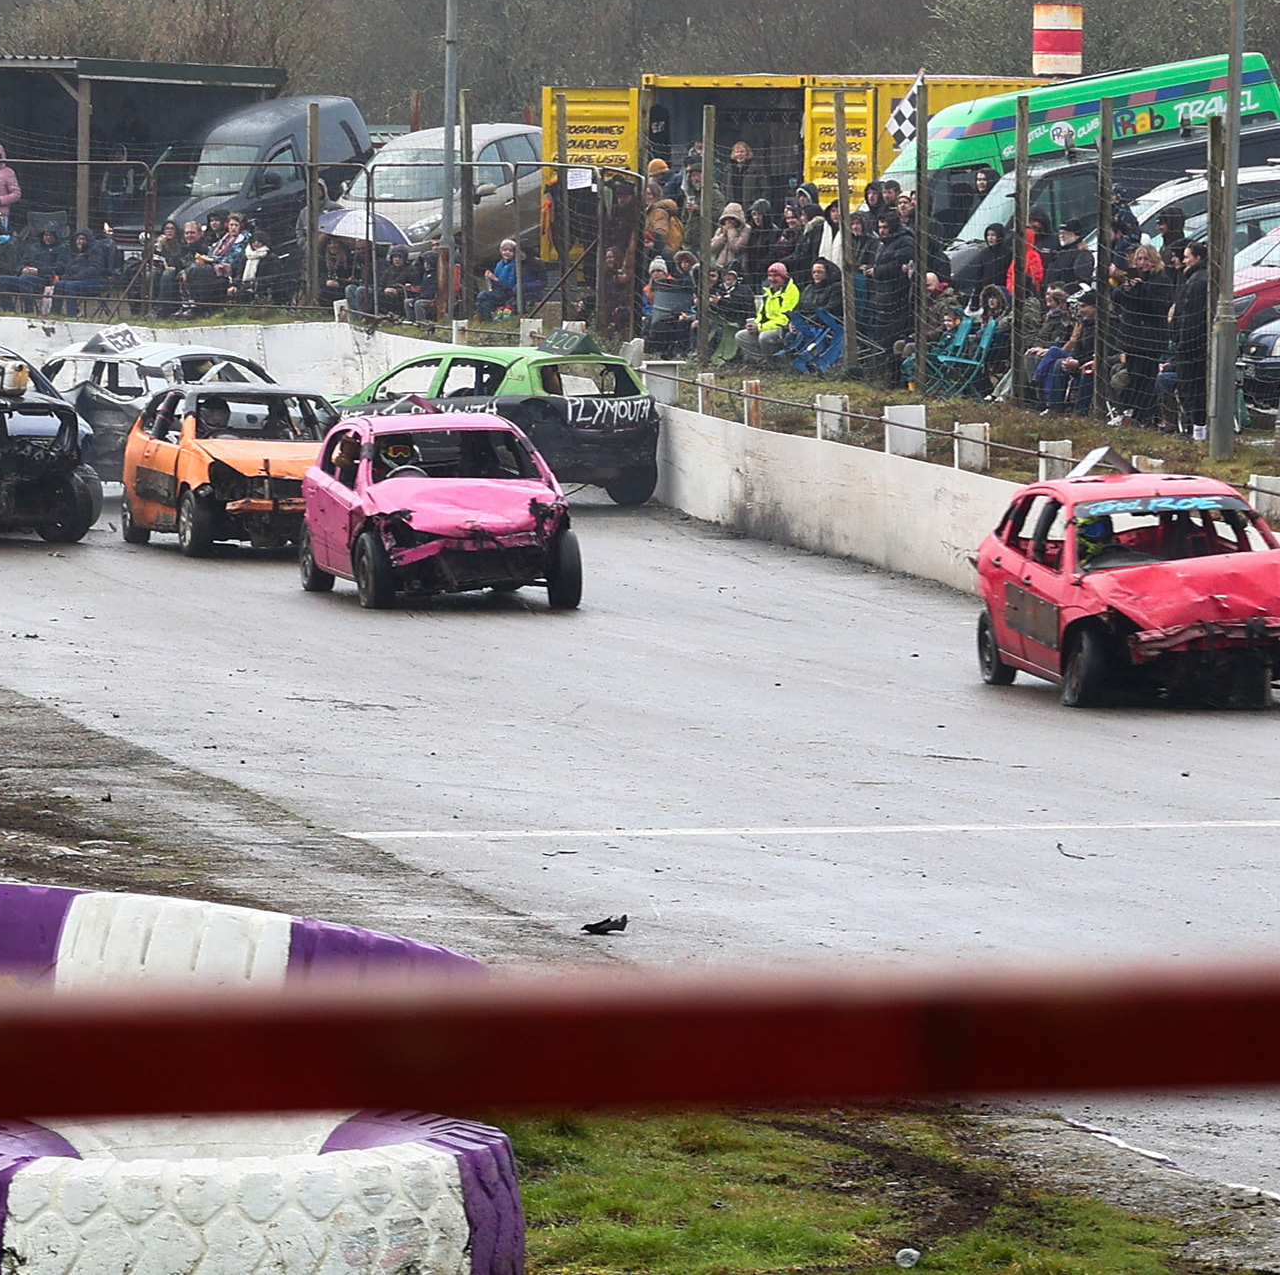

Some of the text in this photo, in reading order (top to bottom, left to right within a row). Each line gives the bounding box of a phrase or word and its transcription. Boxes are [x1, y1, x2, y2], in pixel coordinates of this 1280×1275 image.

[566, 125, 625, 135] ROGRAMMES
[566, 139, 620, 150] OUVENIRS
[545, 328, 579, 351] 420
[567, 396, 651, 424] PLYMOUTH
